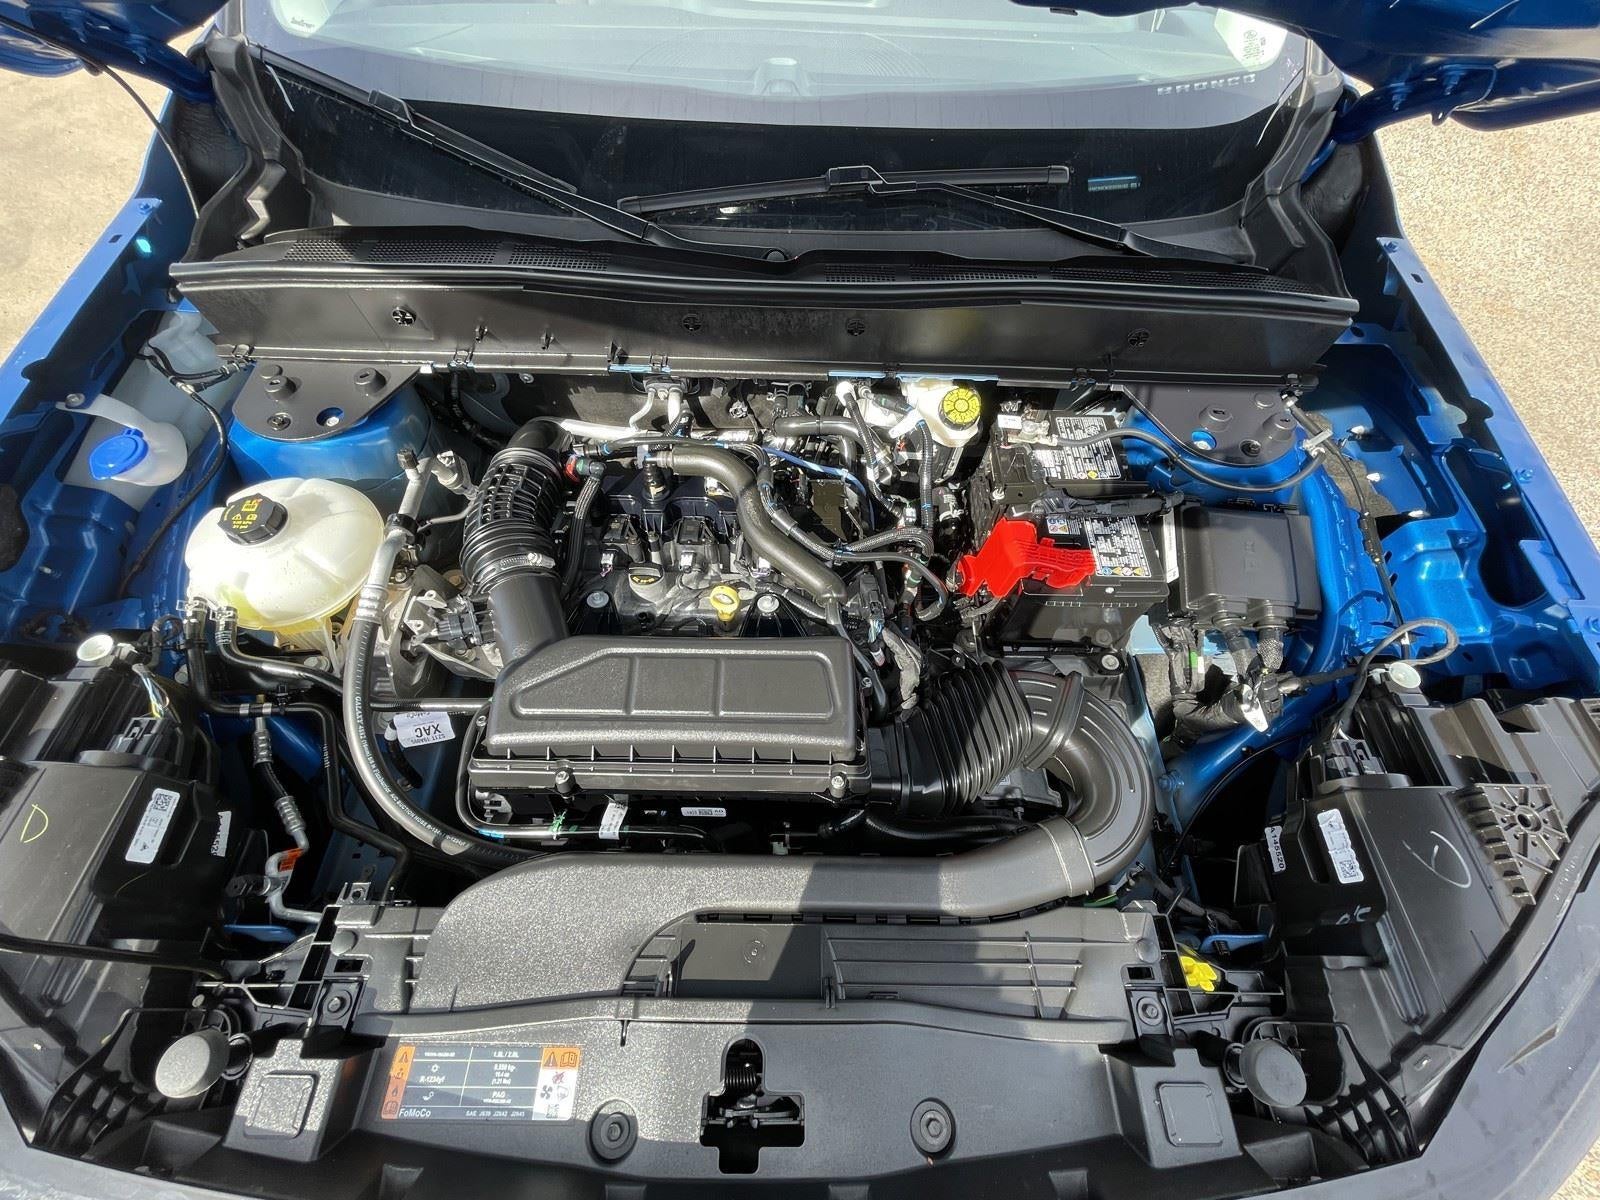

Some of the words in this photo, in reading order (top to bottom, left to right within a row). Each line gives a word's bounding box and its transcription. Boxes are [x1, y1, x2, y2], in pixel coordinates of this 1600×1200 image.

[1157, 73, 1256, 96] BRONCO
[415, 723, 442, 738] XAC
[398, 1108, 432, 1119] FoMoCo
